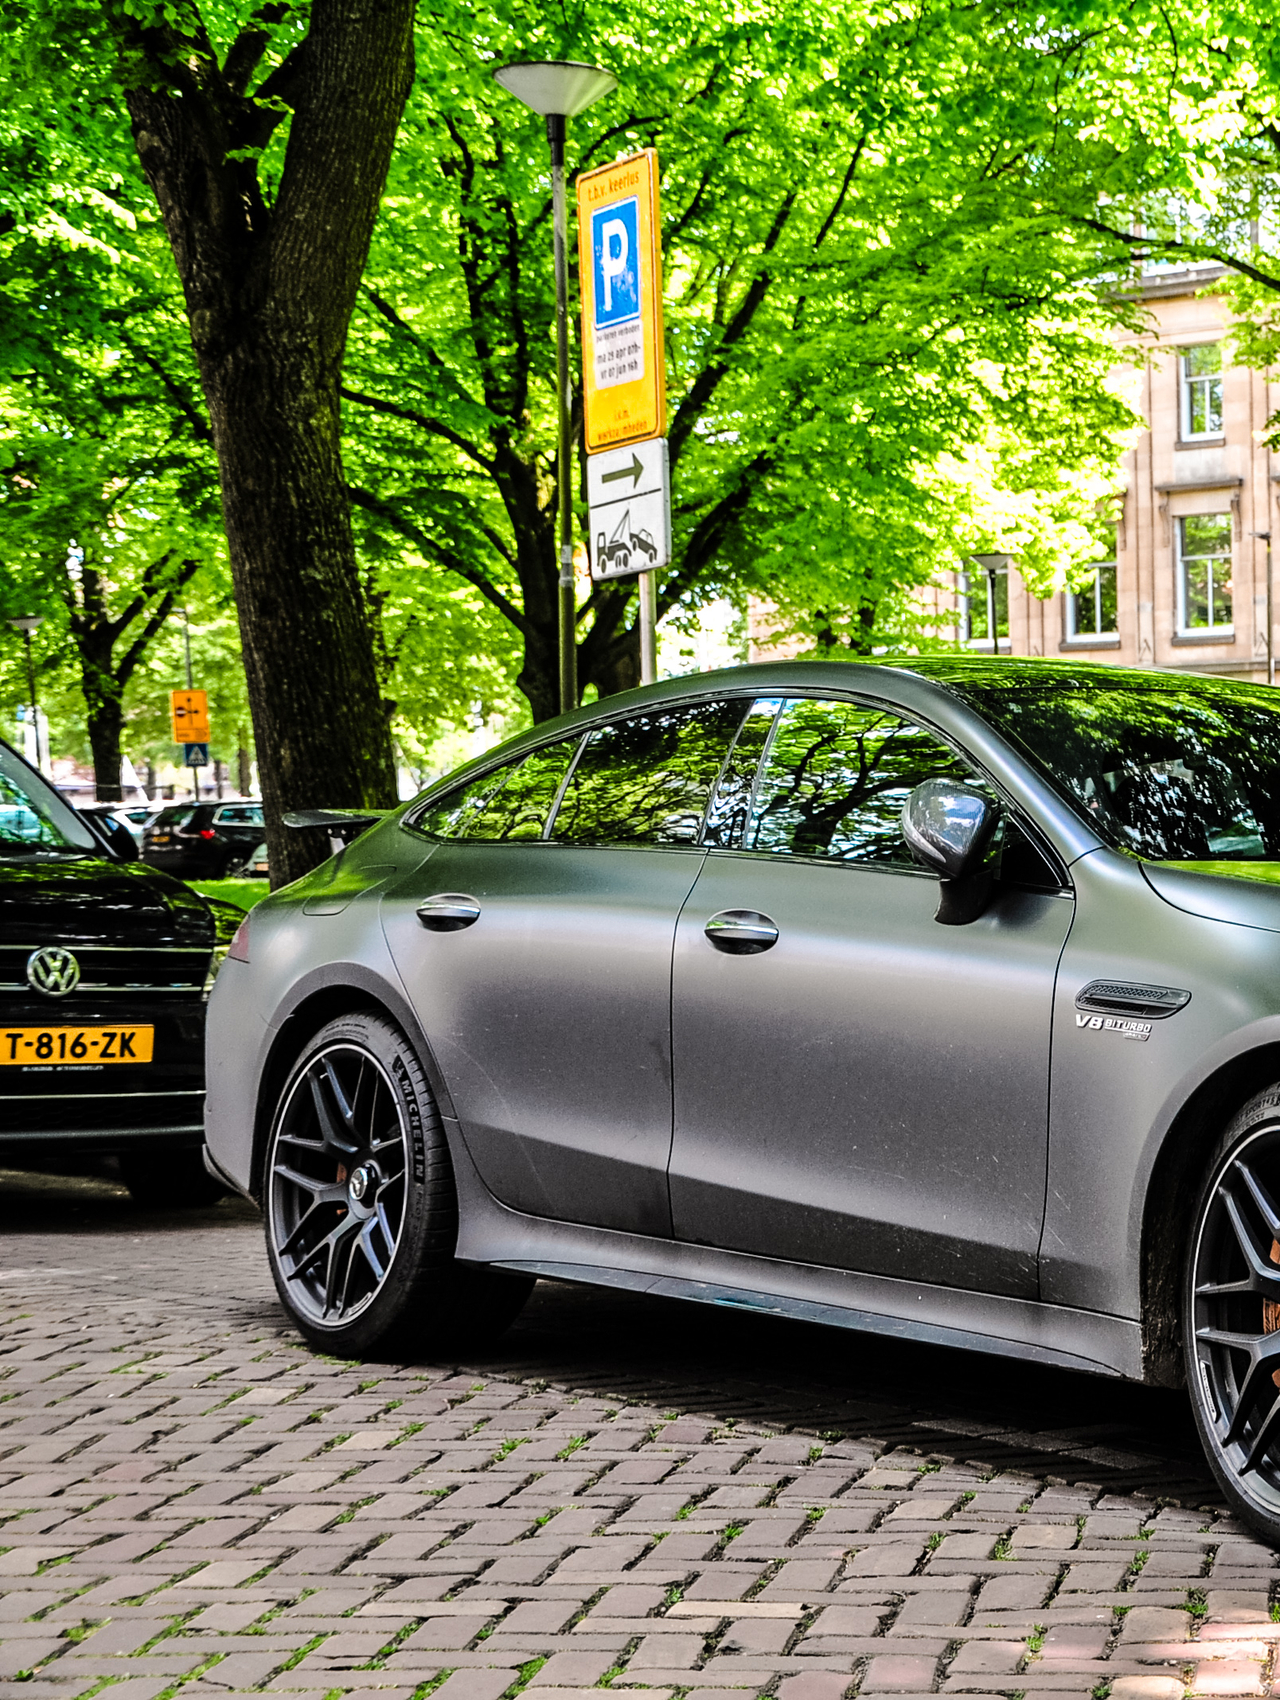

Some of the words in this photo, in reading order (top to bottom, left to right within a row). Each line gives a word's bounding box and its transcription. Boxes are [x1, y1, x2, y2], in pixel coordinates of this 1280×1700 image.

[609, 171, 640, 194] keerlus
[602, 218, 629, 312] P
[615, 362, 626, 380] jun
[1075, 1014, 1104, 1031] V8
[1105, 1018, 1152, 1033] BITURBO
[5, 1032, 137, 1060] T-816-ZK
[401, 1079, 424, 1178] MICHELIN
